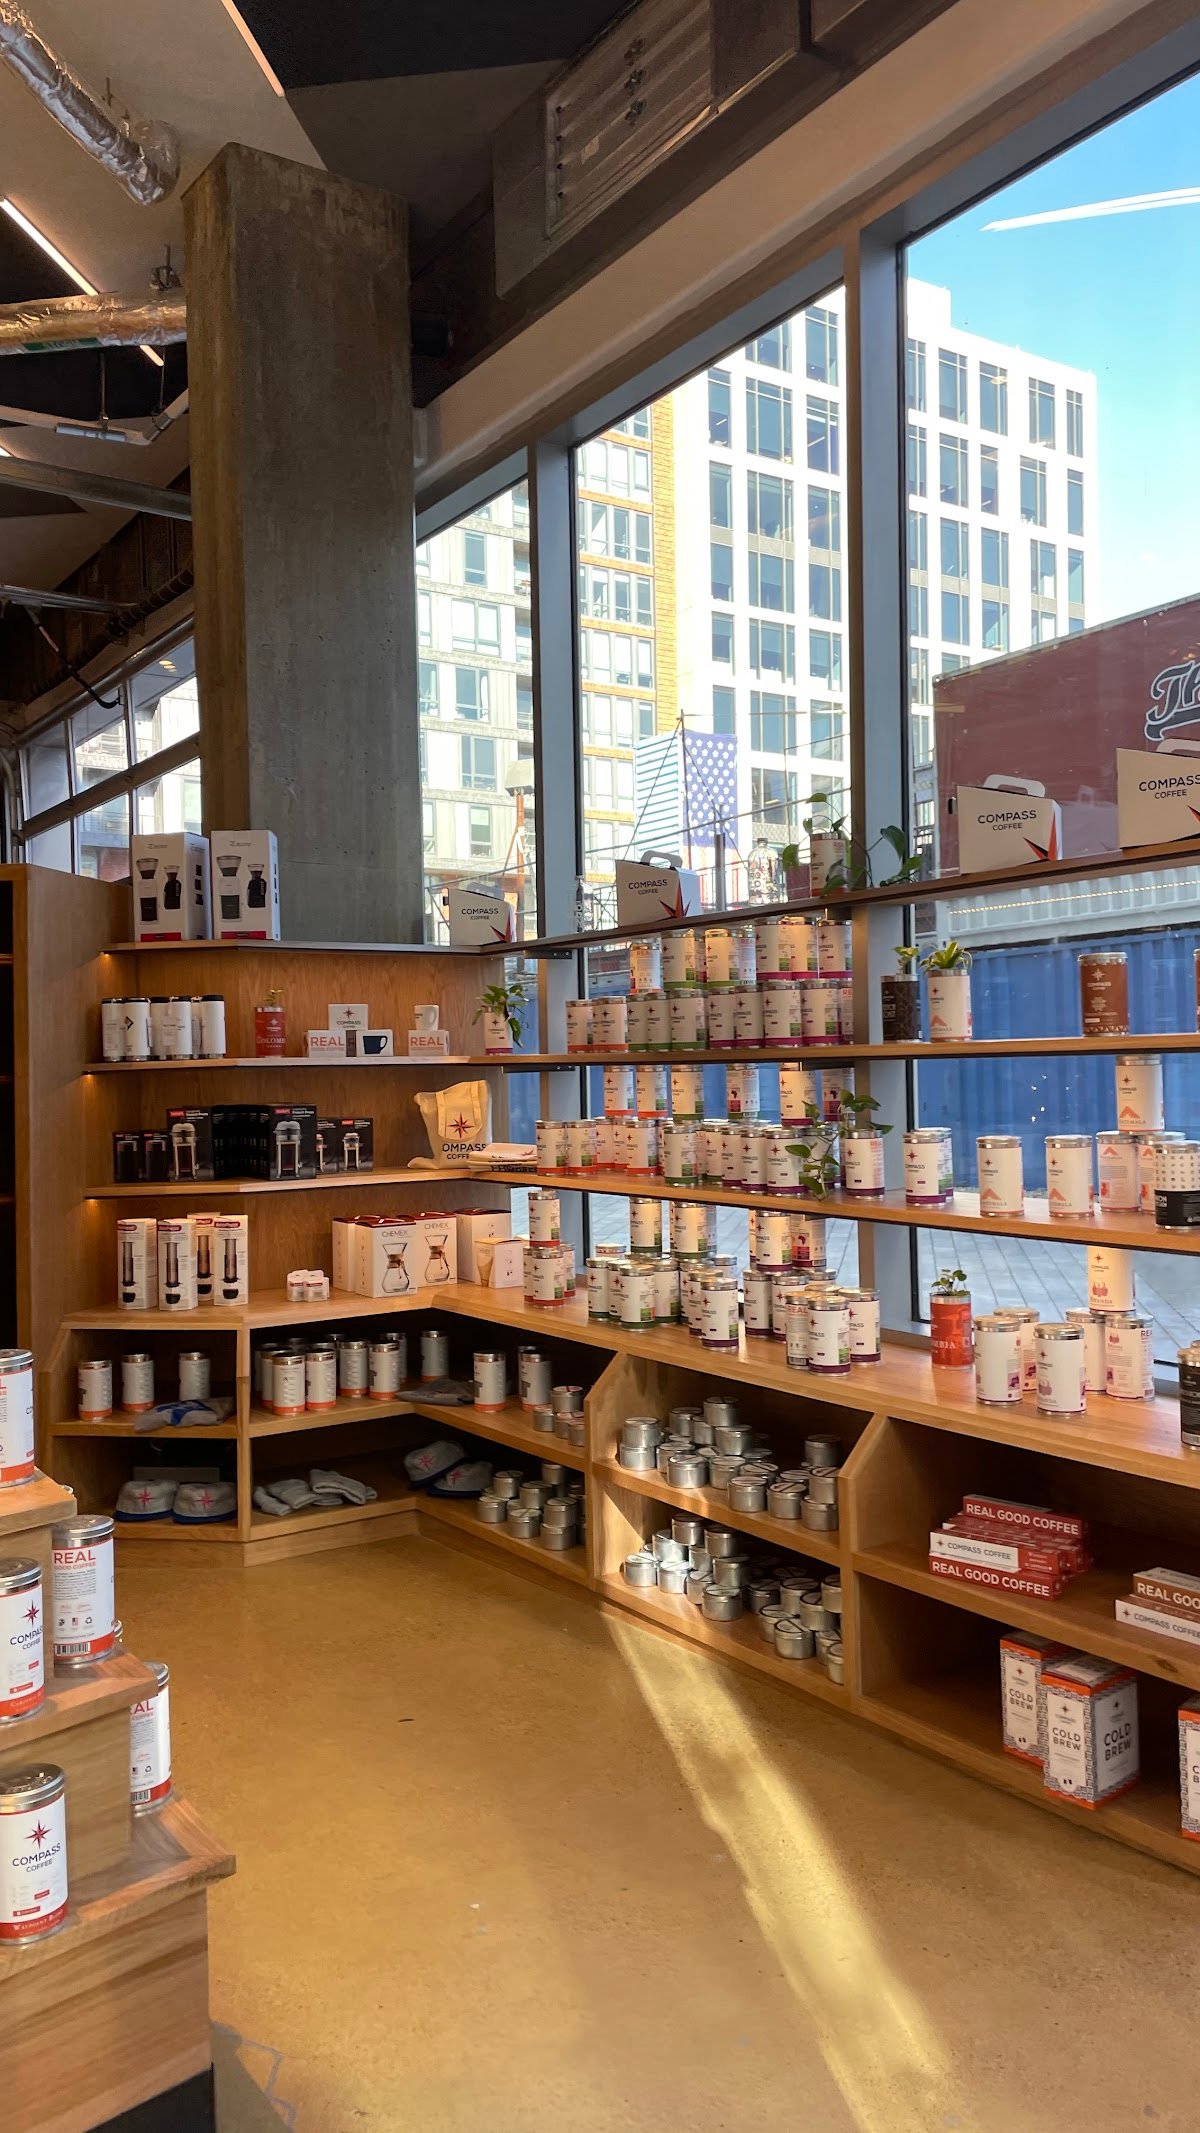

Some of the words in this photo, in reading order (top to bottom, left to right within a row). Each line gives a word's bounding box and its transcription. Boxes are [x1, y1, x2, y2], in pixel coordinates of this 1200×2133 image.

[1138, 774, 1200, 792] COMPASS
[1154, 789, 1187, 799] COFFEE
[977, 809, 1037, 824] COMPASS
[992, 822, 1023, 831] COFFEE
[628, 879, 668, 890] COMPASS
[310, 1036, 345, 1047] REAL
[410, 1036, 444, 1046] REAL
[381, 1229, 408, 1238] CHEMEX
[424, 1222, 449, 1230] CHEMEX
[966, 1503, 996, 1519] REAL
[996, 1510, 1031, 1525] GOOD
[1032, 1517, 1080, 1536] COFFEE
[54, 1549, 96, 1564] REAL
[947, 1541, 982, 1555] COMPASS
[984, 1548, 1012, 1560] COFFEE
[932, 1561, 964, 1577] REAL
[964, 1568, 1000, 1585] GOOD
[1001, 1576, 1050, 1597] COFFEE
[1136, 1582, 1171, 1602] REAL
[1133, 1612, 1171, 1630] COMPASS
[1009, 1688, 1034, 1703] COLD
[1009, 1697, 1034, 1711] BREW
[1052, 1727, 1081, 1742] COLD
[1103, 1722, 1131, 1747] COLD
[1052, 1736, 1081, 1751] BREW
[1104, 1740, 1131, 1761] BREW
[12, 1842, 61, 1867] COMPASS
[26, 1858, 53, 1873] COFFEE
